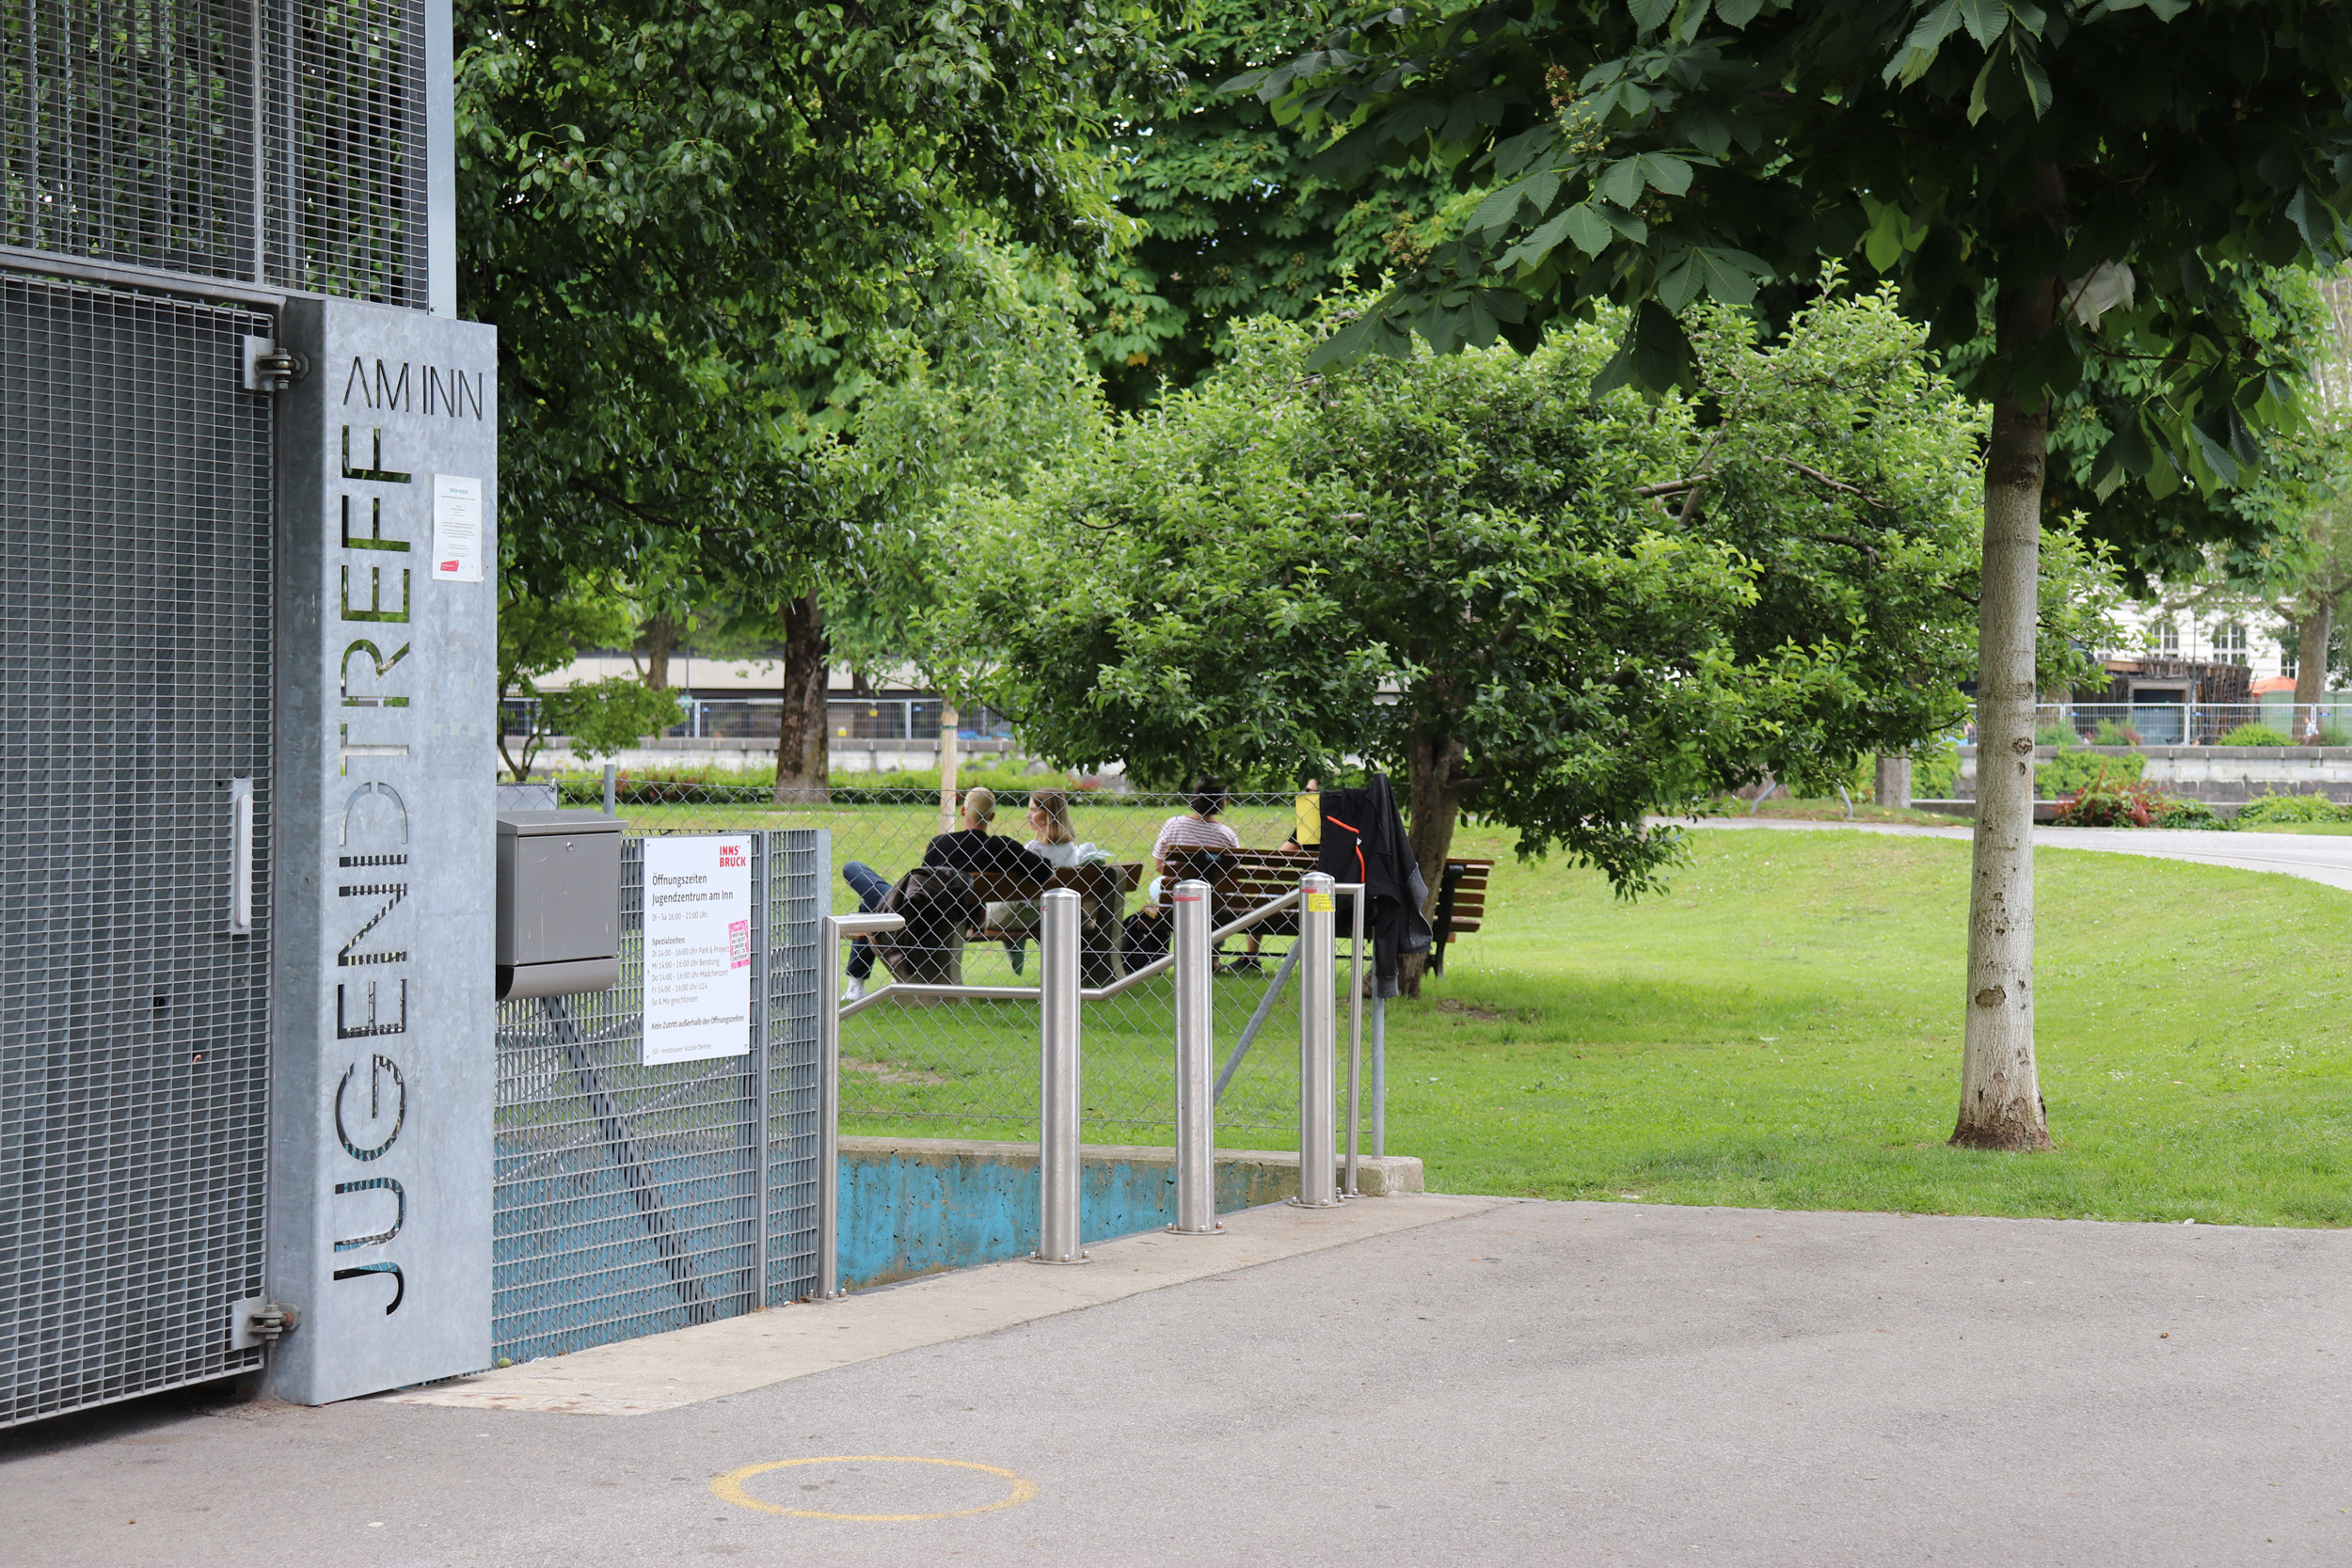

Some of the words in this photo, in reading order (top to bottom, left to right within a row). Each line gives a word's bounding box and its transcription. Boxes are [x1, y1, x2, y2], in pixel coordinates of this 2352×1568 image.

[343, 356, 409, 413] AM
[422, 364, 483, 421] INN
[720, 857, 746, 867] BRUCK
[334, 424, 412, 1317] JUGENDTREFF
[652, 873, 707, 888] Öffnungszeiten
[652, 891, 707, 907] Jugendzentrum
[708, 892, 721, 901] am
[722, 890, 734, 900] Inn
[661, 912, 667, 921] Sa
[668, 912, 682, 921] 16:00
[686, 911, 699, 920] 21:00
[699, 911, 707, 919] Uhr
[652, 936, 686, 946] Spezialzeiten:
[658, 949, 672, 958] 14:00
[675, 947, 689, 957] 16:00
[690, 946, 698, 956] Uhr
[698, 946, 708, 955] Park
[659, 960, 673, 969] 14:00
[676, 959, 690, 968] 16:00
[690, 958, 698, 967] Uhr
[699, 958, 720, 968] Beratung
[652, 974, 659, 982] Do
[660, 973, 673, 981] 14:00
[677, 972, 691, 980] 16:00
[691, 971, 699, 979] Uhr
[700, 969, 728, 978] Mädchenzeit
[658, 985, 672, 993] 14:00
[675, 984, 689, 992] 16:00
[689, 982, 697, 991] Uhr
[698, 982, 707, 990] U14
[652, 998, 658, 1006] So
[671, 995, 698, 1006] geschlossen
[663, 1021, 677, 1029] Zutritt
[678, 1018, 702, 1028] außerhalb
[710, 1014, 744, 1025] Öffnungszeiten
